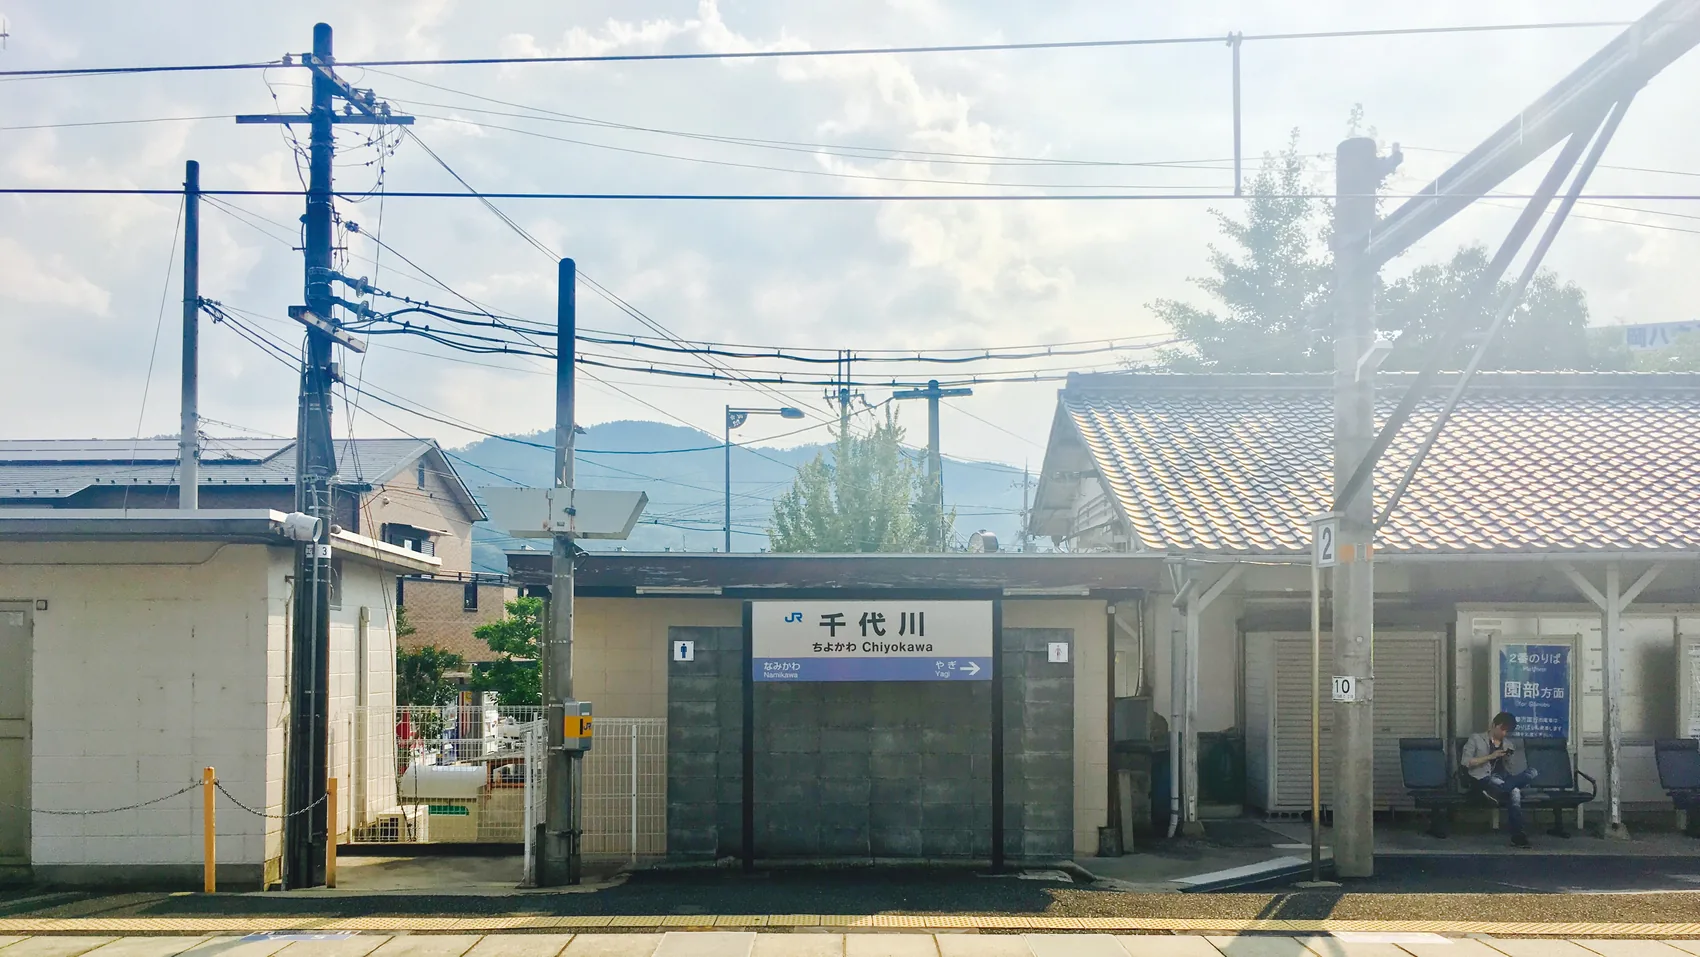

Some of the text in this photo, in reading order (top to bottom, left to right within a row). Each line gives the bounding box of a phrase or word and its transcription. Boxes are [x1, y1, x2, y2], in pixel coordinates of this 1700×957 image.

[1322, 526, 1332, 560] 2
[322, 546, 327, 556] 3
[784, 612, 803, 623] JR
[819, 611, 924, 637] 千代川
[812, 641, 933, 654] ちよかわ Chiyokawa
[1509, 652, 1561, 664] 2番のりば
[763, 662, 801, 671] なみかわ
[935, 660, 957, 670] やぎ
[763, 671, 798, 679] Namikawa
[935, 670, 950, 679] Yagi
[1335, 679, 1350, 694] 10
[1504, 681, 1565, 699] 園部方面
